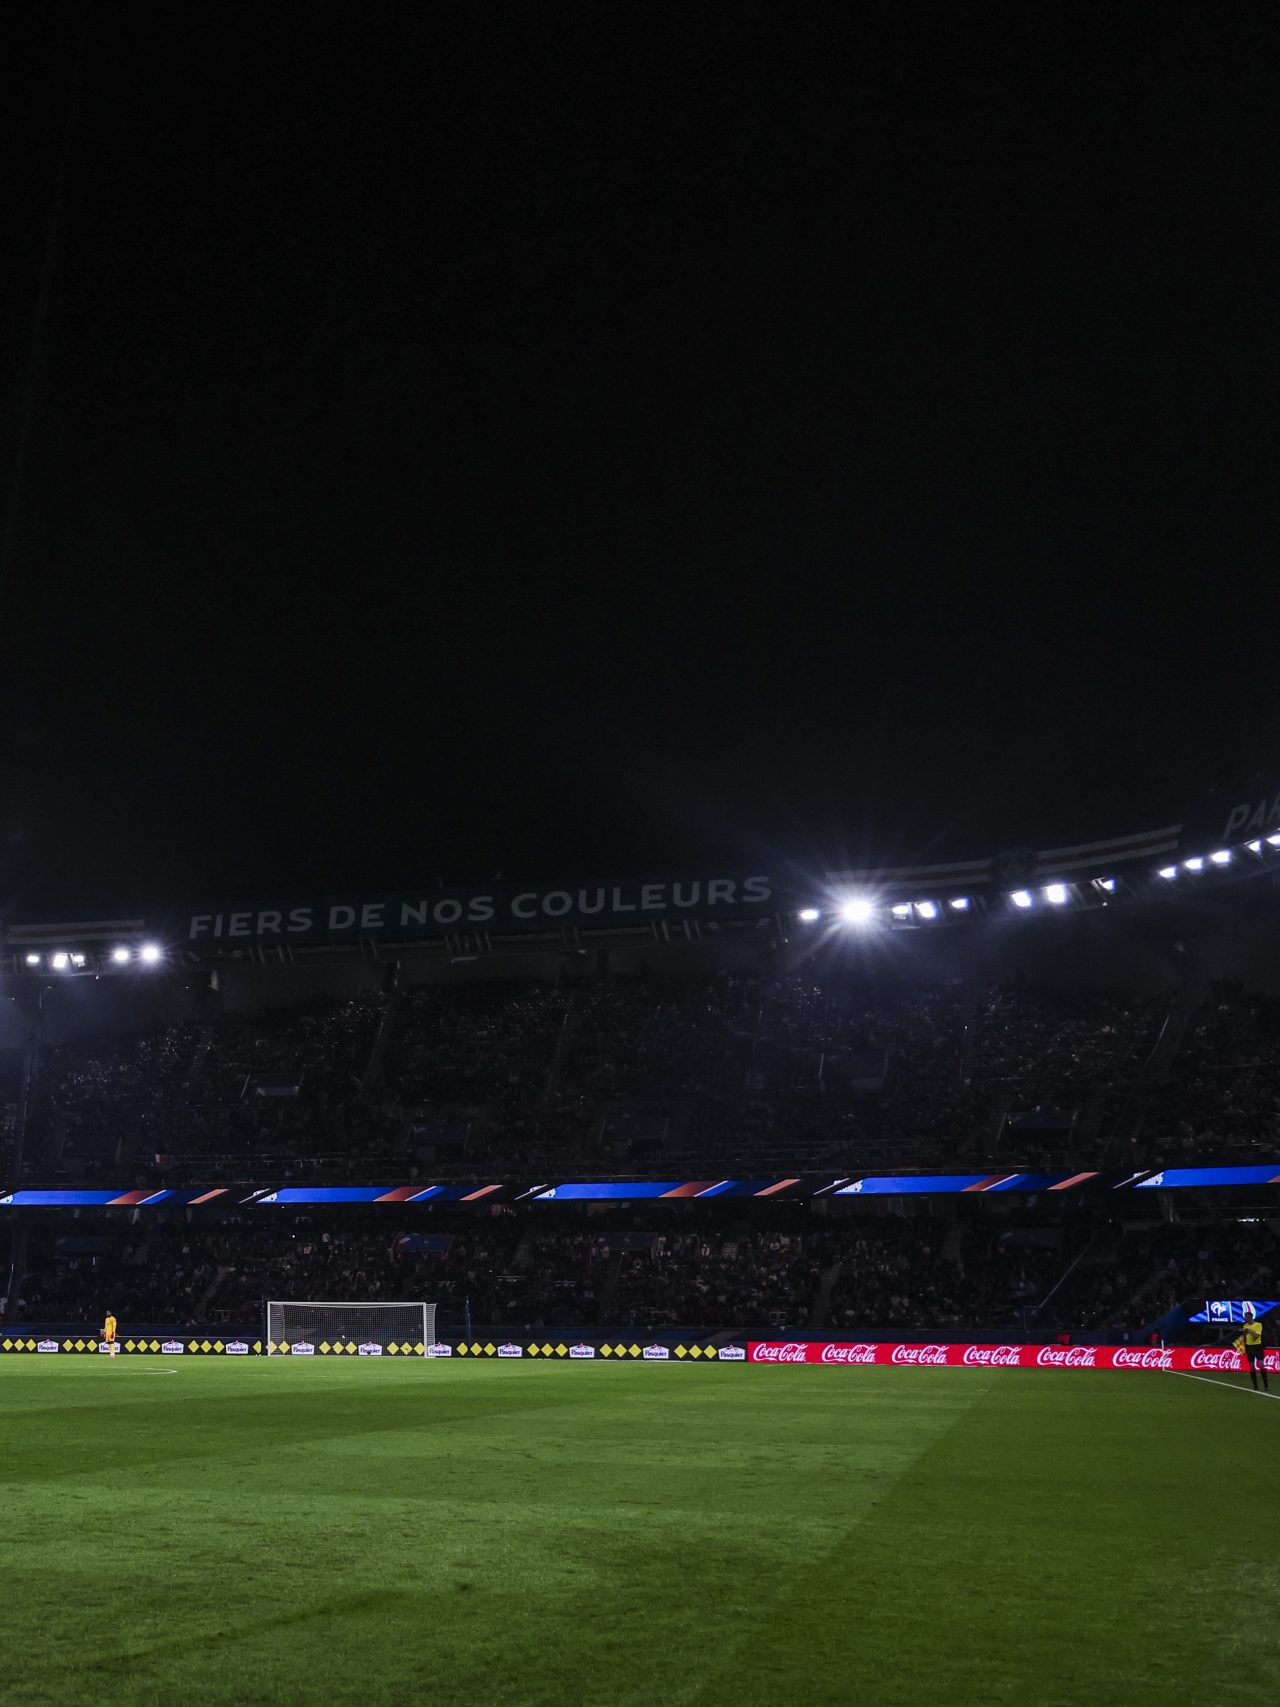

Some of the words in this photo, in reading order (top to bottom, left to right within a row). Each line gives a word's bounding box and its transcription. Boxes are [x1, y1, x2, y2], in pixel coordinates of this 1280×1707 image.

[189, 907, 313, 939] FIERS
[328, 903, 385, 930] DE
[400, 896, 495, 926] NOS
[510, 875, 772, 919] COULEURS
[163, 1345, 182, 1353] Pasquier
[499, 1348, 521, 1356] Pasquier
[571, 1349, 593, 1357] Pasquier
[645, 1350, 667, 1358] Pasquier
[720, 1351, 743, 1359] Pasquier
[753, 1343, 808, 1362] Coca-Cola
[821, 1344, 879, 1363] Coca-Cola
[891, 1344, 949, 1364] Coca-Cola
[963, 1345, 1022, 1365] Coca-Cola
[1036, 1346, 1098, 1366] Coca-Cola
[1112, 1347, 1175, 1367] Coca-Cola
